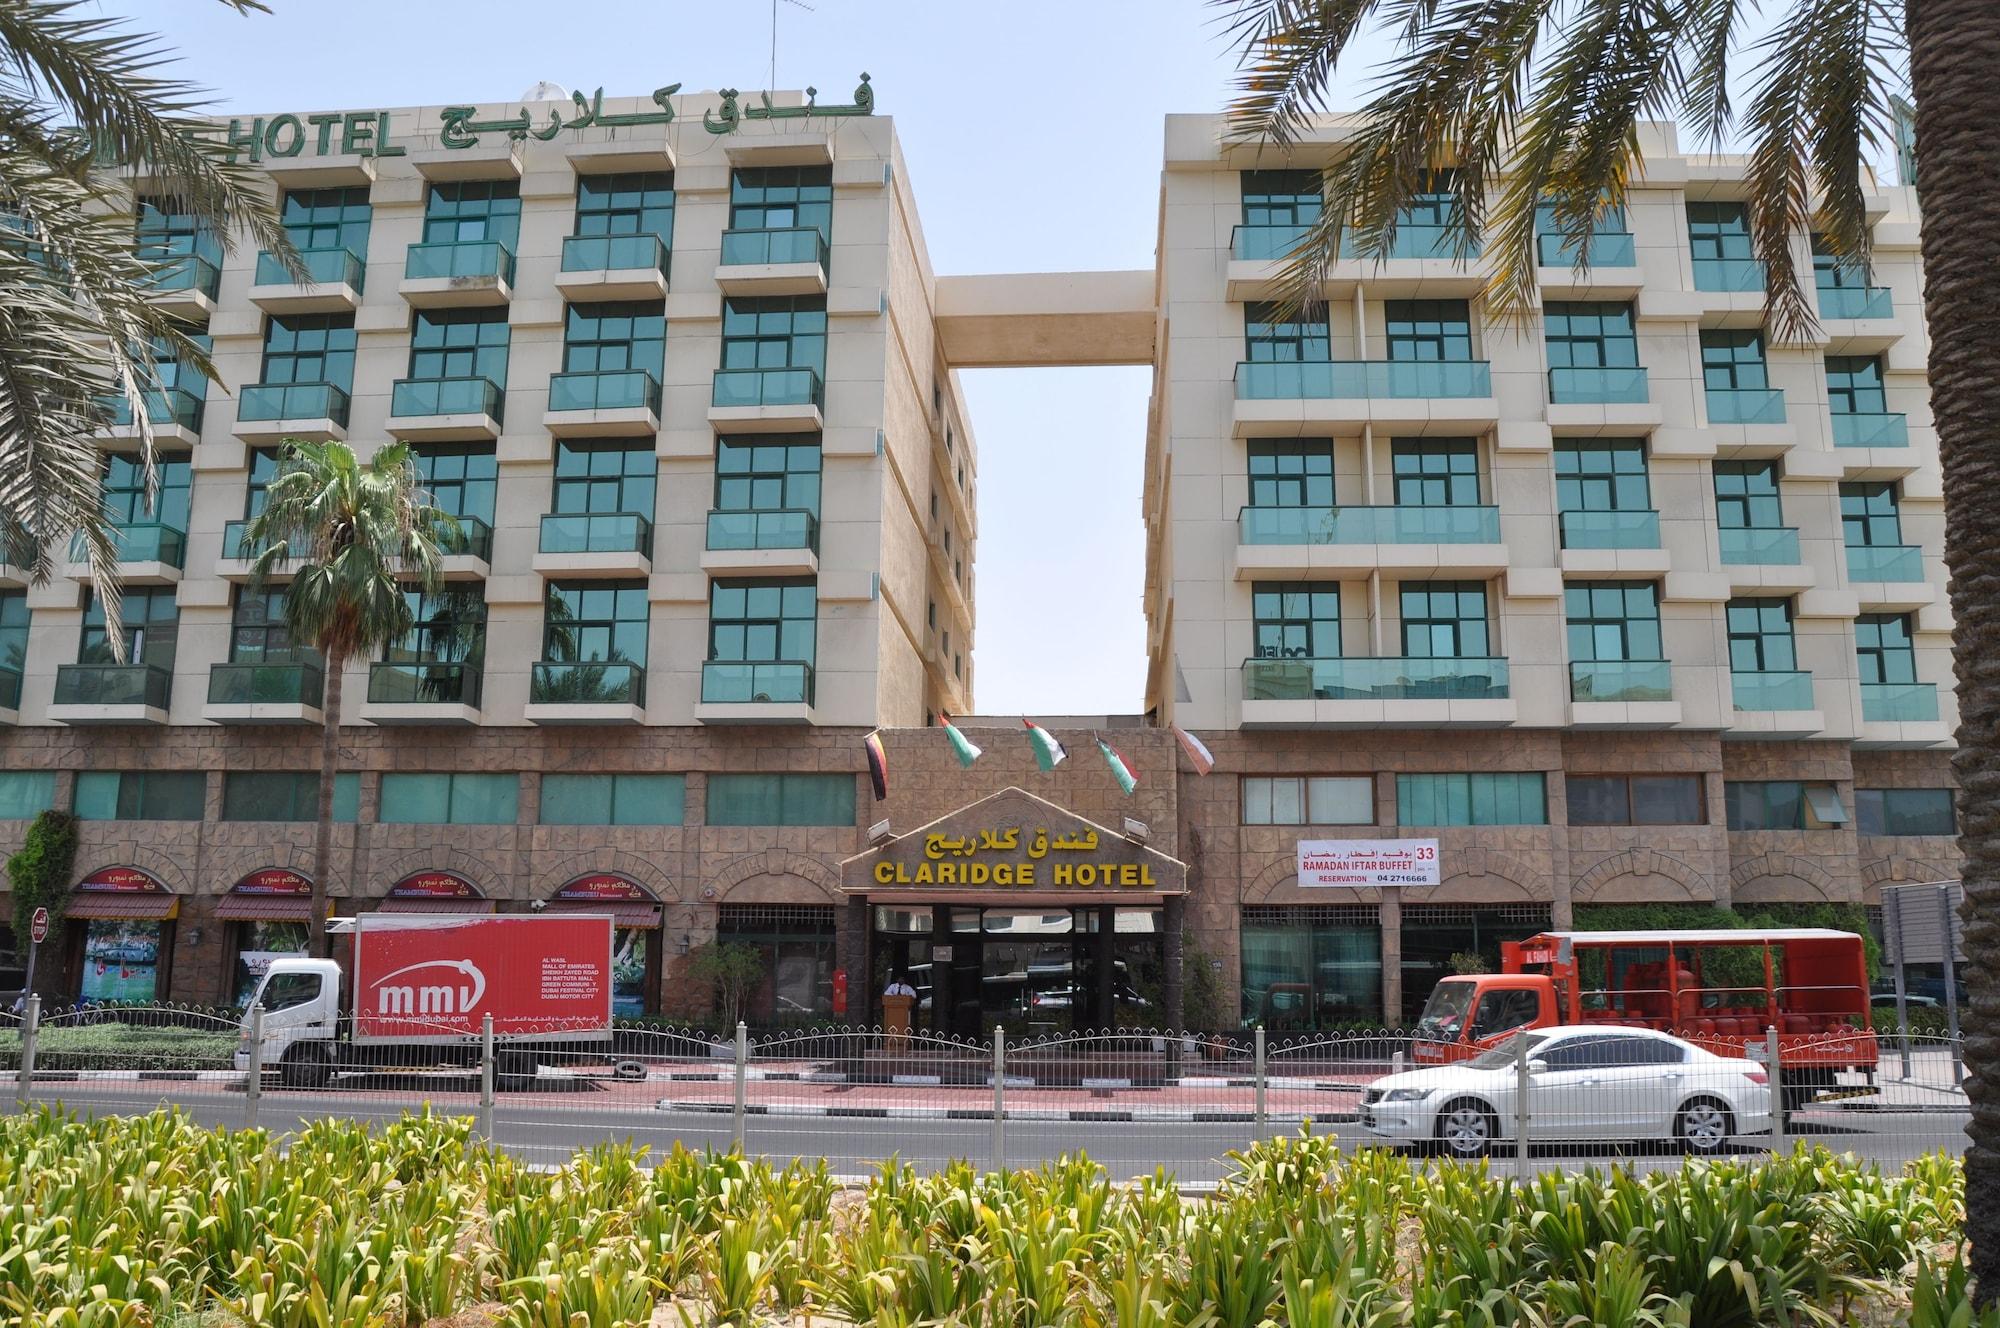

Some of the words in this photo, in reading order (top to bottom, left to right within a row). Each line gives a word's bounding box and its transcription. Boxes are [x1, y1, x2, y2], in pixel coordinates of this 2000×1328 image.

[440, 82, 682, 149] كلاريج
[702, 71, 875, 134] فندق
[226, 110, 407, 164] HOTEL
[924, 828, 1020, 859] كلاريج
[1027, 827, 1099, 858] فندق
[1416, 847, 1435, 860] 33
[874, 861, 1035, 885] CLARIDGE
[1054, 863, 1157, 886] HOTEL
[1303, 861, 1349, 871] RAMADAN
[1352, 861, 1377, 871] IFTAR
[1379, 861, 1412, 871] BUFFET
[34, 926, 46, 935] STOP
